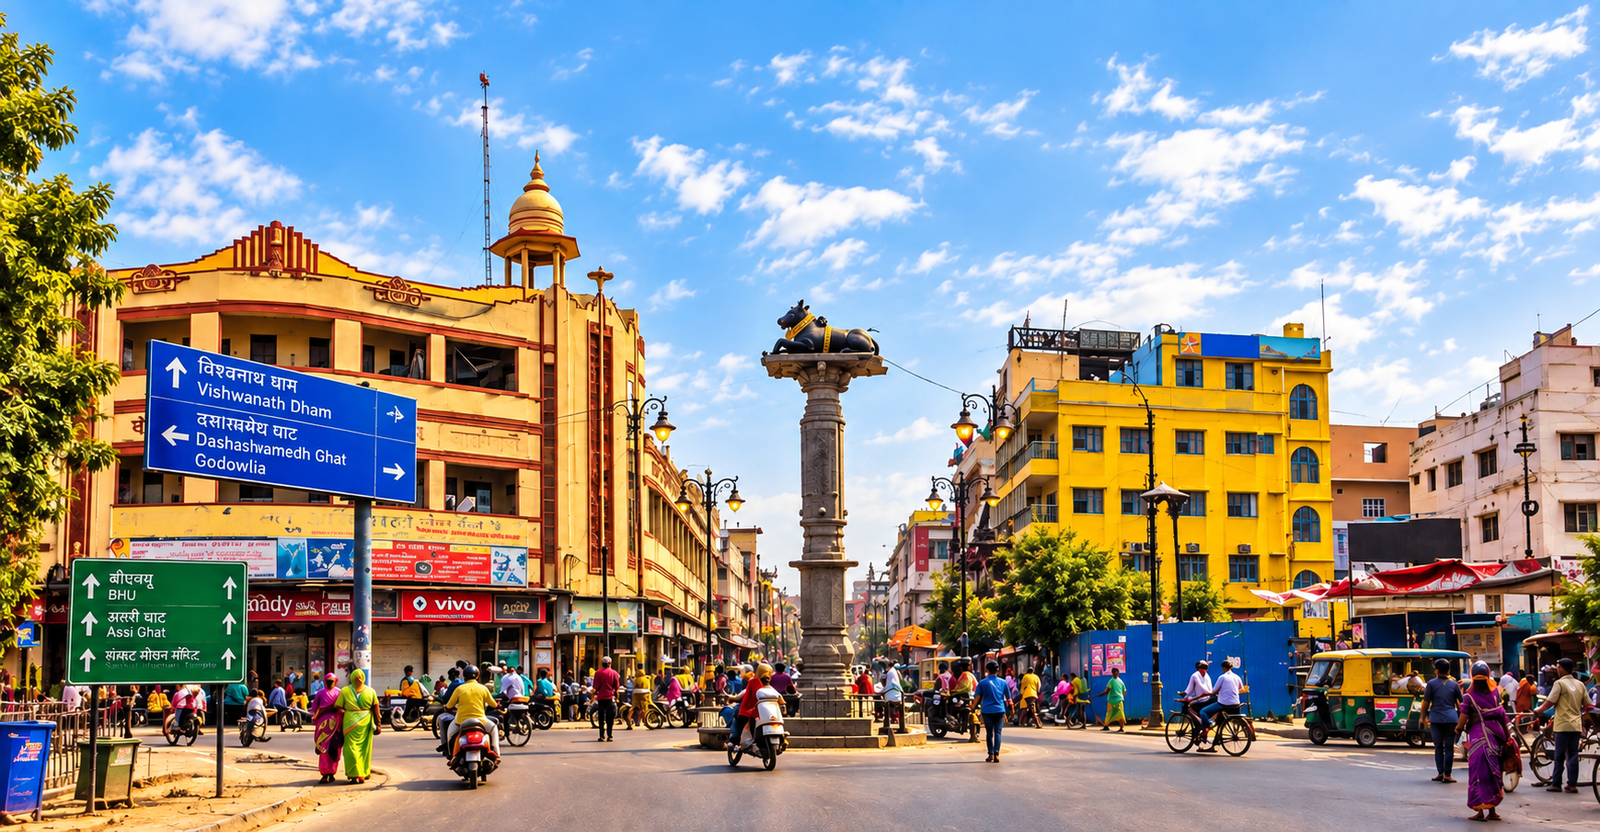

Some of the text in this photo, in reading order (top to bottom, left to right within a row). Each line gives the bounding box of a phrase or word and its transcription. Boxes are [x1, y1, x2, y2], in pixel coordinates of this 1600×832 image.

[197, 355, 298, 393] विश्वनाथ धाम
[197, 381, 332, 419] Vishwanath Dham
[272, 424, 298, 441] घाट
[195, 453, 266, 475] Godowlia
[315, 449, 347, 466] Ghat
[108, 589, 136, 601] BHU
[434, 596, 476, 611] vivo
[143, 612, 167, 624] घाट
[106, 625, 167, 638] Assi Ghat
